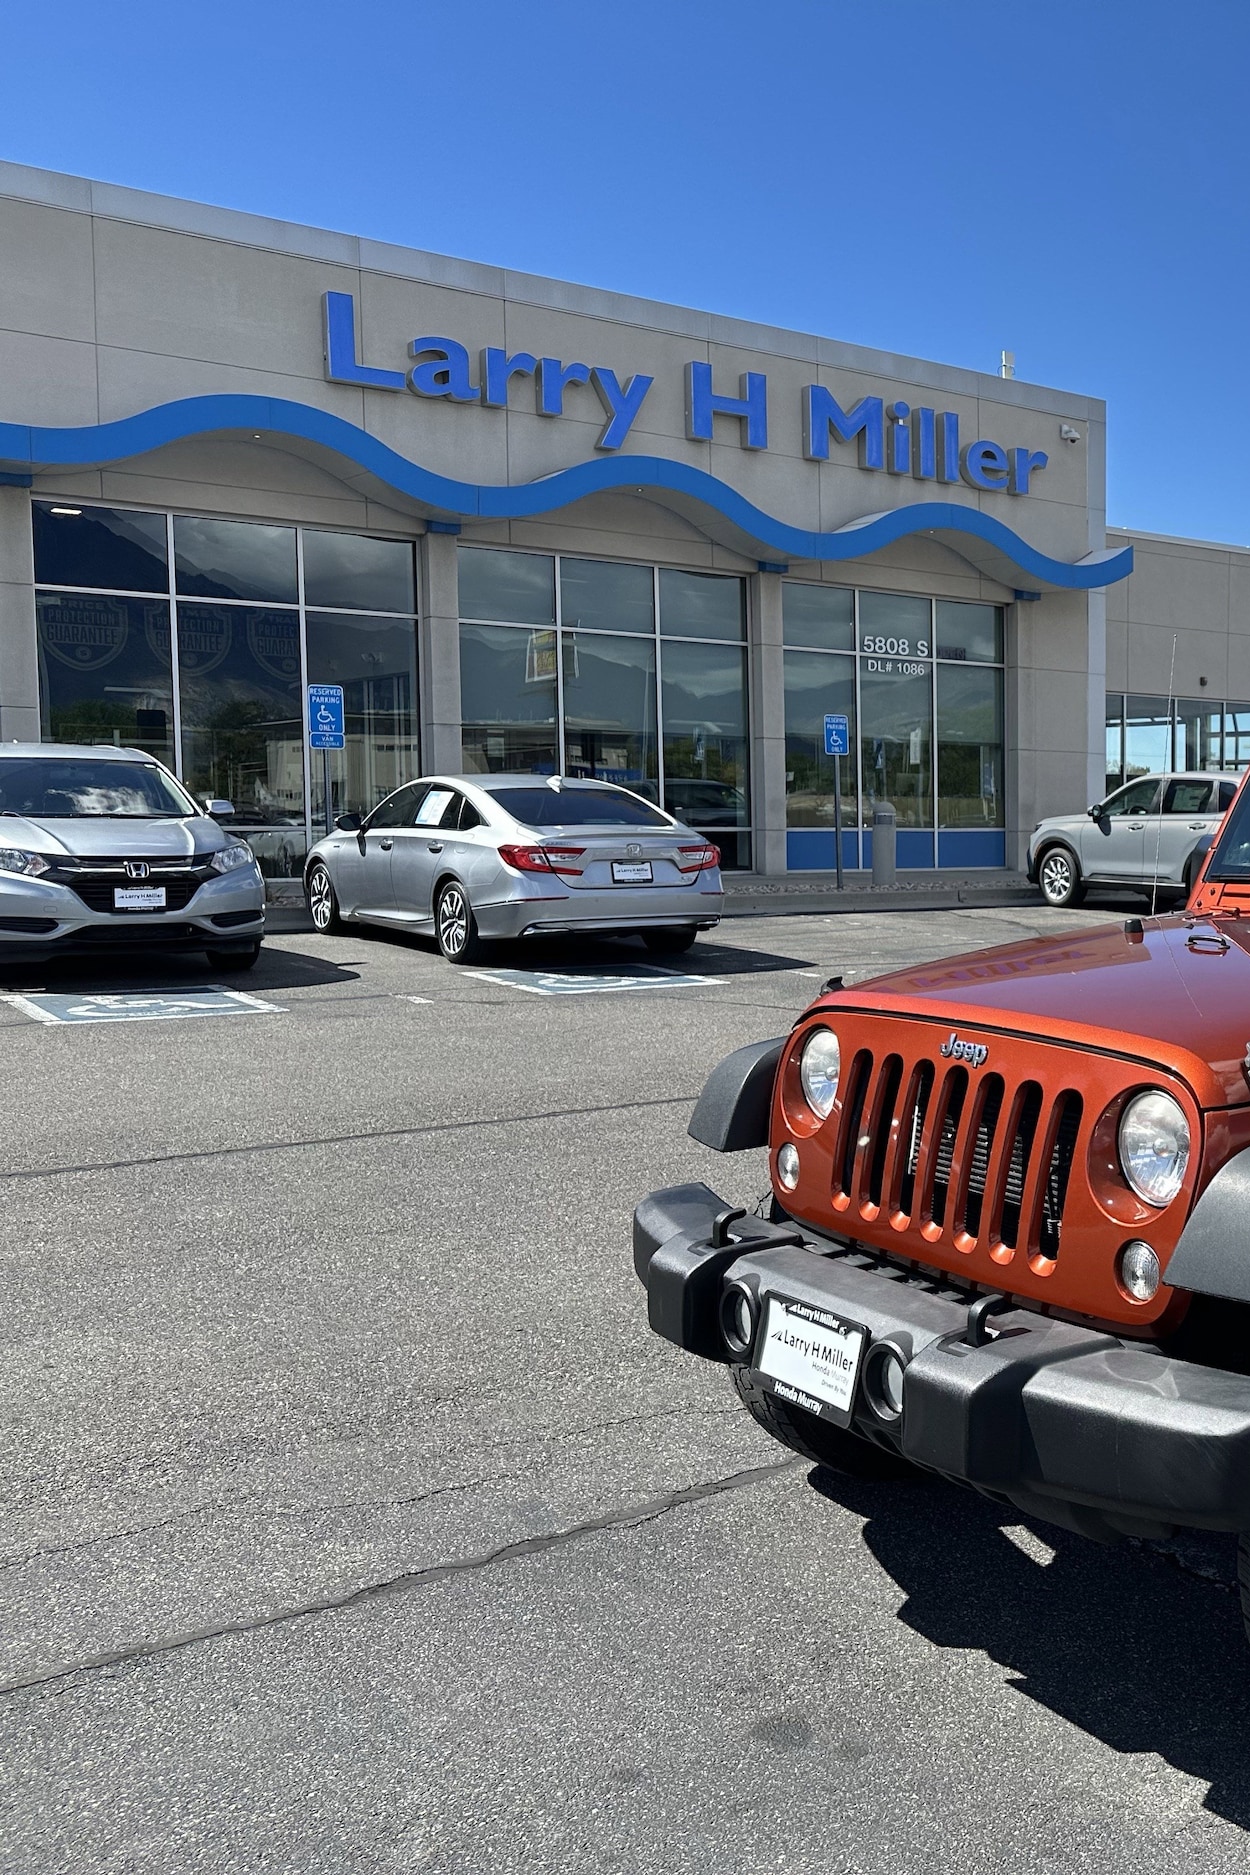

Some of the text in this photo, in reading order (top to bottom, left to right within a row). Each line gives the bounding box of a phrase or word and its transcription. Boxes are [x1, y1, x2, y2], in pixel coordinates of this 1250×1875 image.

[323, 291, 1048, 497] Larry H Miller
[48, 608, 117, 626] PROTECTION
[46, 624, 118, 645] GUARANTEE
[258, 623, 296, 638] PROTEC
[155, 631, 223, 651] GURANTEE
[257, 638, 297, 656] GUARA
[863, 635, 910, 656] 5808
[917, 640, 929, 657] S
[867, 660, 925, 676] DL# 1086
[310, 687, 341, 696] RESERVED
[311, 696, 340, 704] PARKING
[318, 724, 336, 732] ONLY
[940, 1032, 988, 1068] Jeep
[797, 1303, 814, 1321] Larry
[820, 1311, 840, 1329] Miller
[784, 1329, 854, 1372] Larry H Miller
[811, 1361, 830, 1377] Honda
[773, 1380, 823, 1416] Honda Murray
